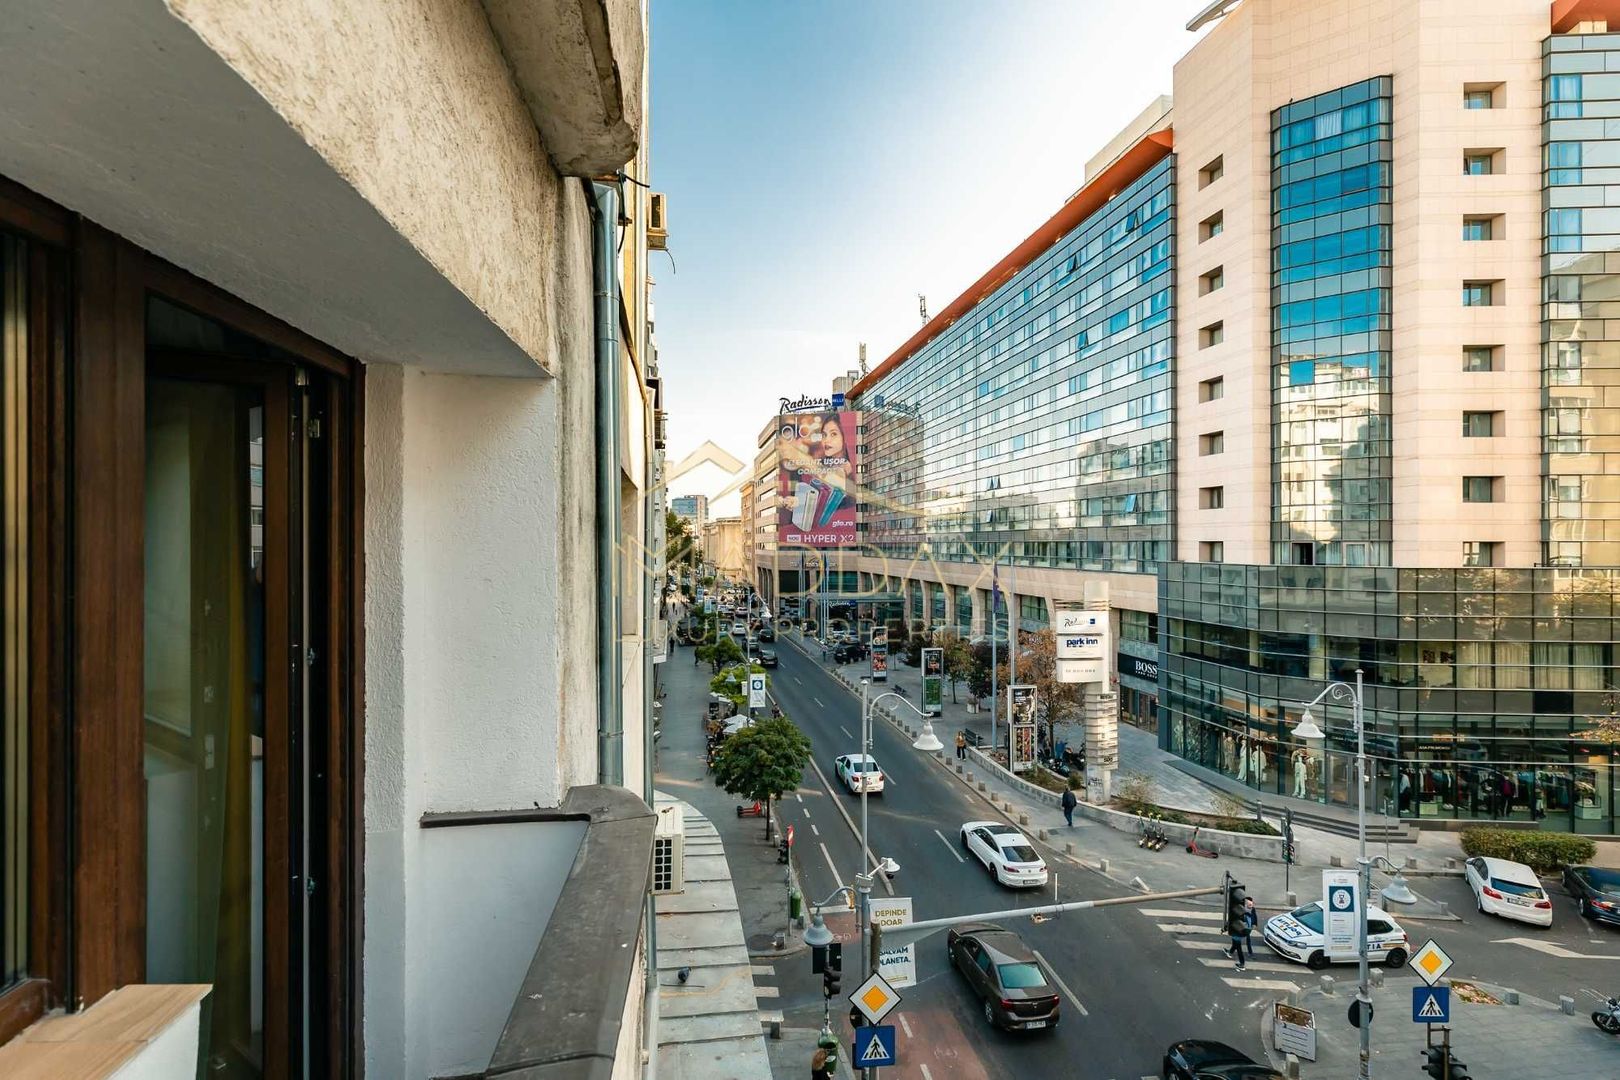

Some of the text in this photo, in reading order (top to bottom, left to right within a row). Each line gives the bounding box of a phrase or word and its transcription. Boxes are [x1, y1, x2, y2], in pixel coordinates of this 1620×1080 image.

[779, 394, 831, 415] Radisson
[804, 534, 837, 543] HYPER
[840, 534, 854, 543] X2
[1066, 638, 1085, 648] park
[1135, 660, 1158, 675] BOSS
[875, 909, 907, 917] DEPINDE
